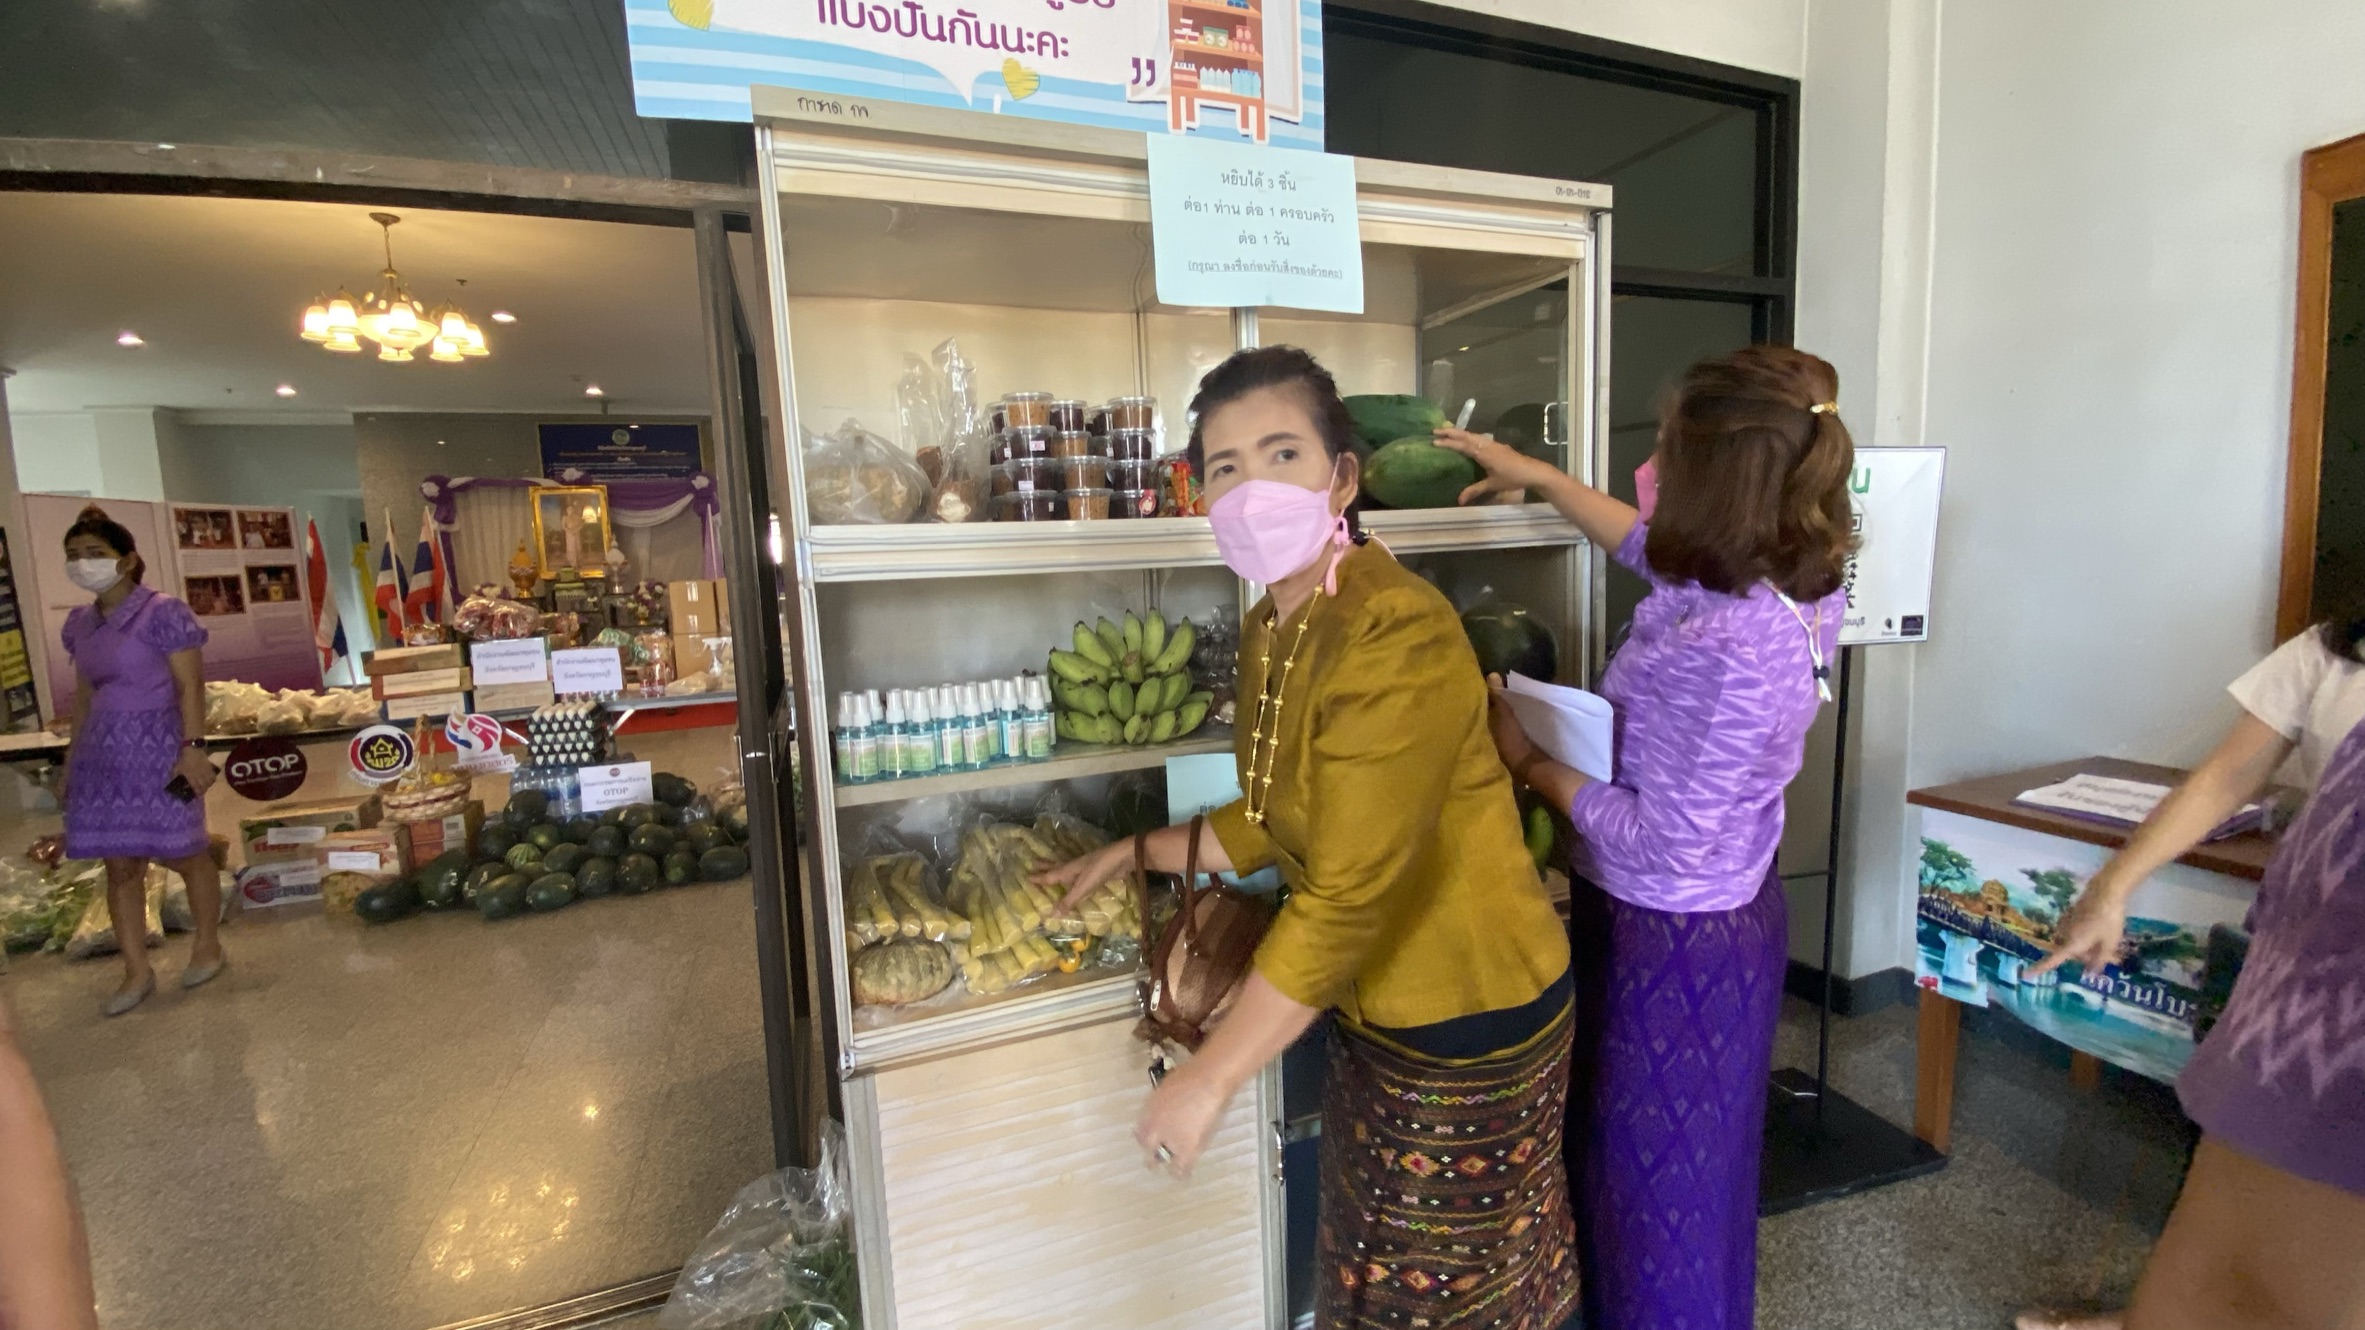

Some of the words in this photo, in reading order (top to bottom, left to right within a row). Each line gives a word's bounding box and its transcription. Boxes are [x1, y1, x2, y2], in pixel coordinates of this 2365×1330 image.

[1221, 168, 1263, 188] หยิบได้
[1268, 178, 1274, 189] 3
[1278, 171, 1297, 191] ชิ้น
[1214, 199, 1241, 216] ท่าน
[1246, 201, 1264, 217] ต่อ
[1269, 207, 1275, 217] 1
[1280, 207, 1335, 223] ครอบครัว
[1238, 230, 1257, 245] ต่อ
[1263, 234, 1269, 245] 1
[1273, 230, 1290, 246] วัน
[231, 753, 299, 778] OTOP
[603, 787, 628, 797] OTOP
